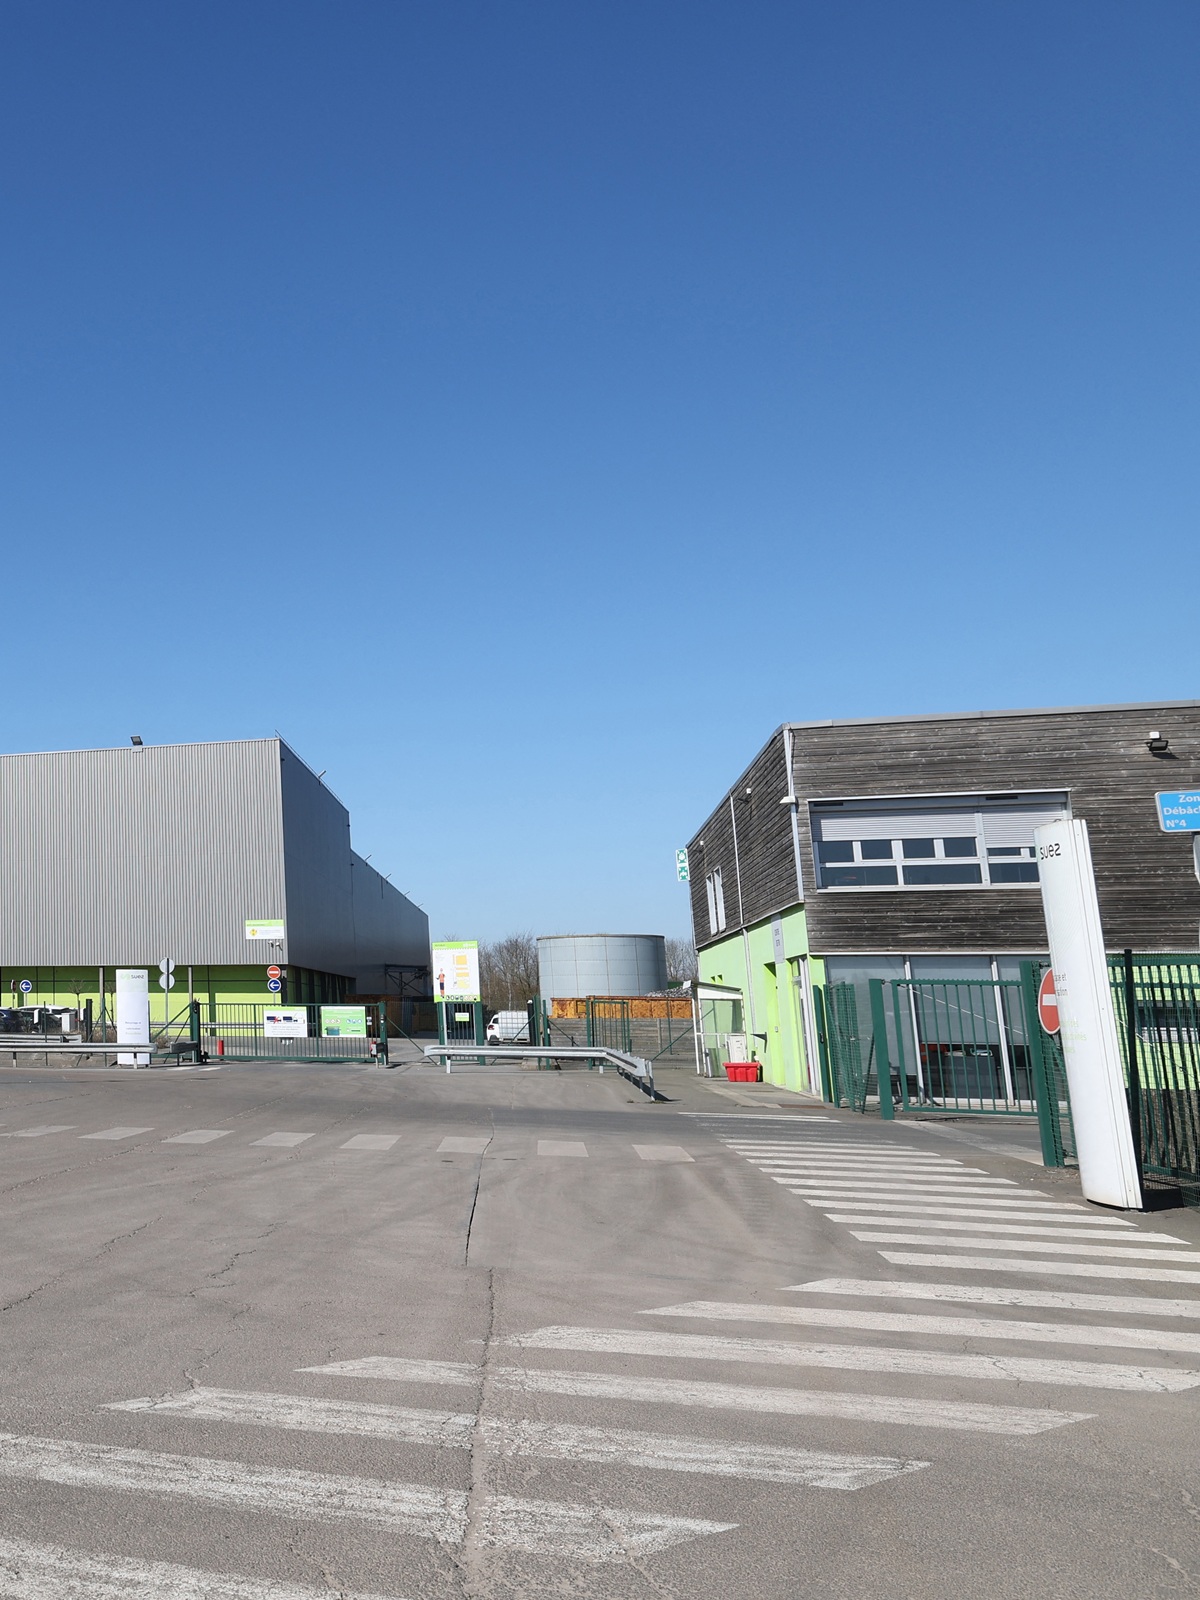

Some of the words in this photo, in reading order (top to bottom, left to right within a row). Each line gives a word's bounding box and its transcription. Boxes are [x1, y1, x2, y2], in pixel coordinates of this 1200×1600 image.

[1178, 794, 1200, 803] Zon
[1163, 806, 1200, 815] Débâc
[1166, 819, 1187, 828] N°4
[1040, 843, 1061, 860] suez
